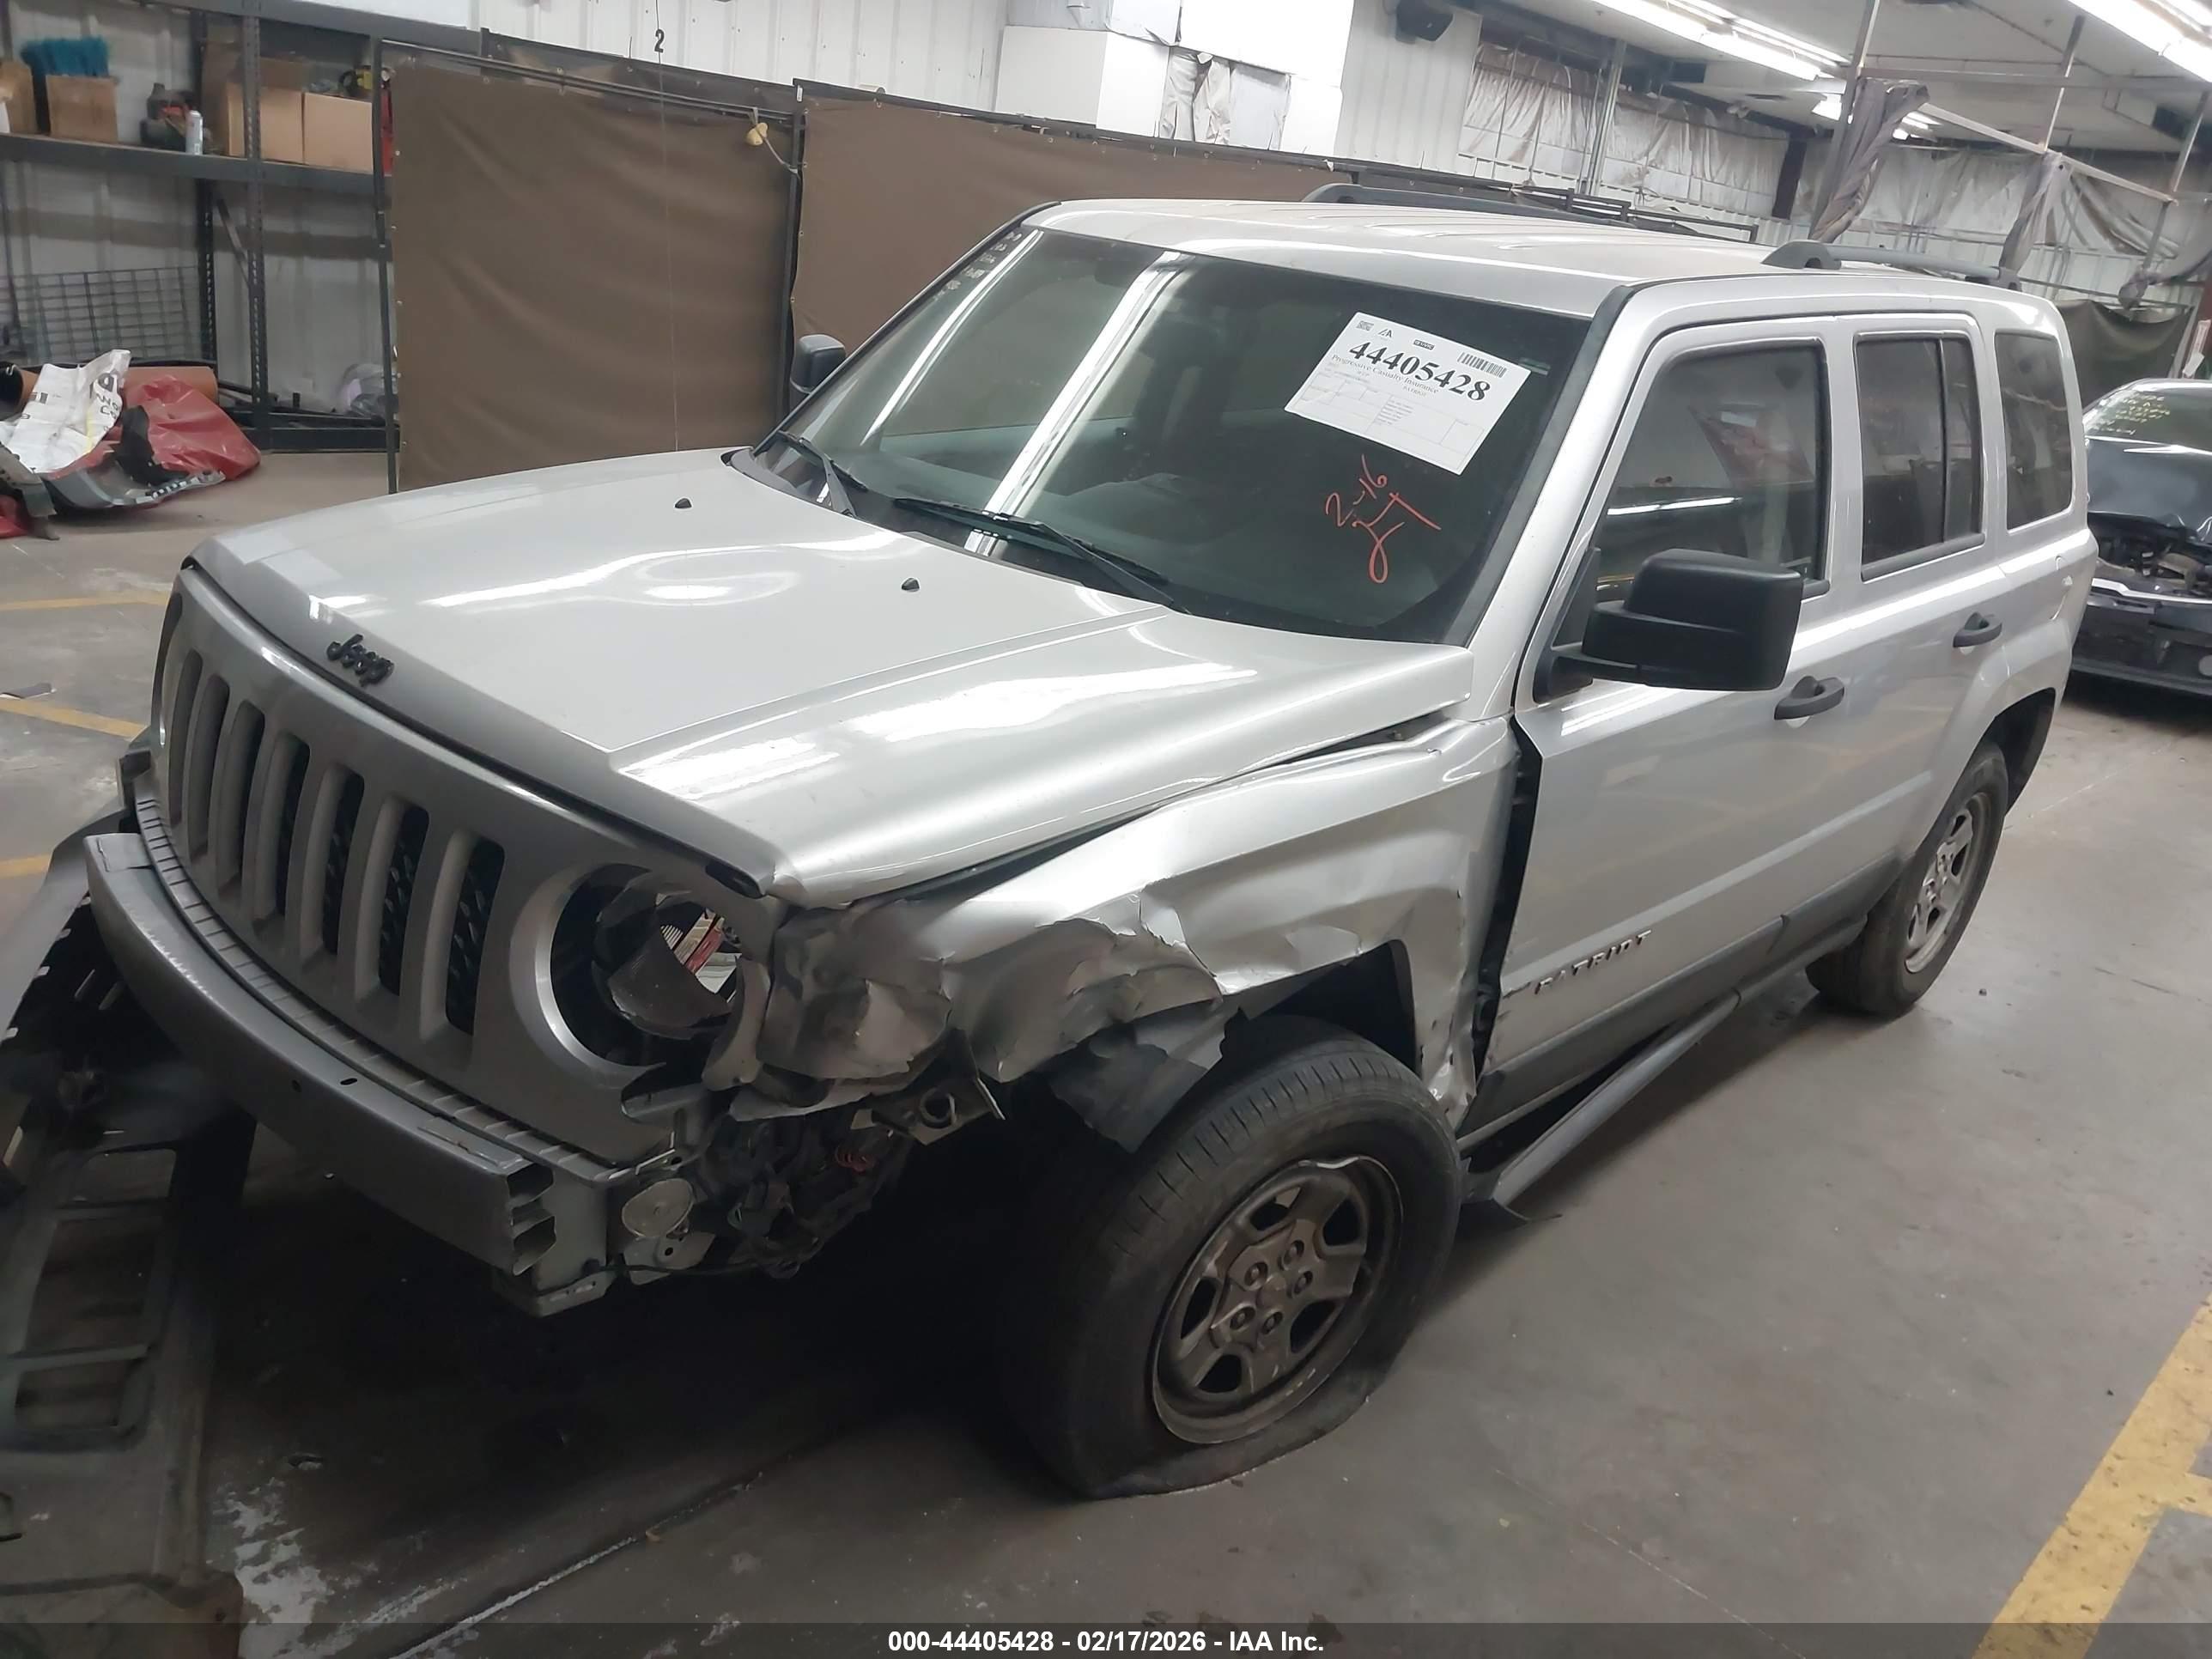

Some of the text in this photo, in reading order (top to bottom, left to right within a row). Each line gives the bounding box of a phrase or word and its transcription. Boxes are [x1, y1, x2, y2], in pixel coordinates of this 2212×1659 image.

[654, 28, 665, 53] 2
[1332, 354, 1372, 372] Progressive
[1372, 367, 1402, 382] Casualty
[1404, 377, 1439, 394] Insurance
[1349, 341, 1491, 402] 44405428
[1325, 453, 1388, 527] 2-16
[326, 634, 395, 687] Jeep
